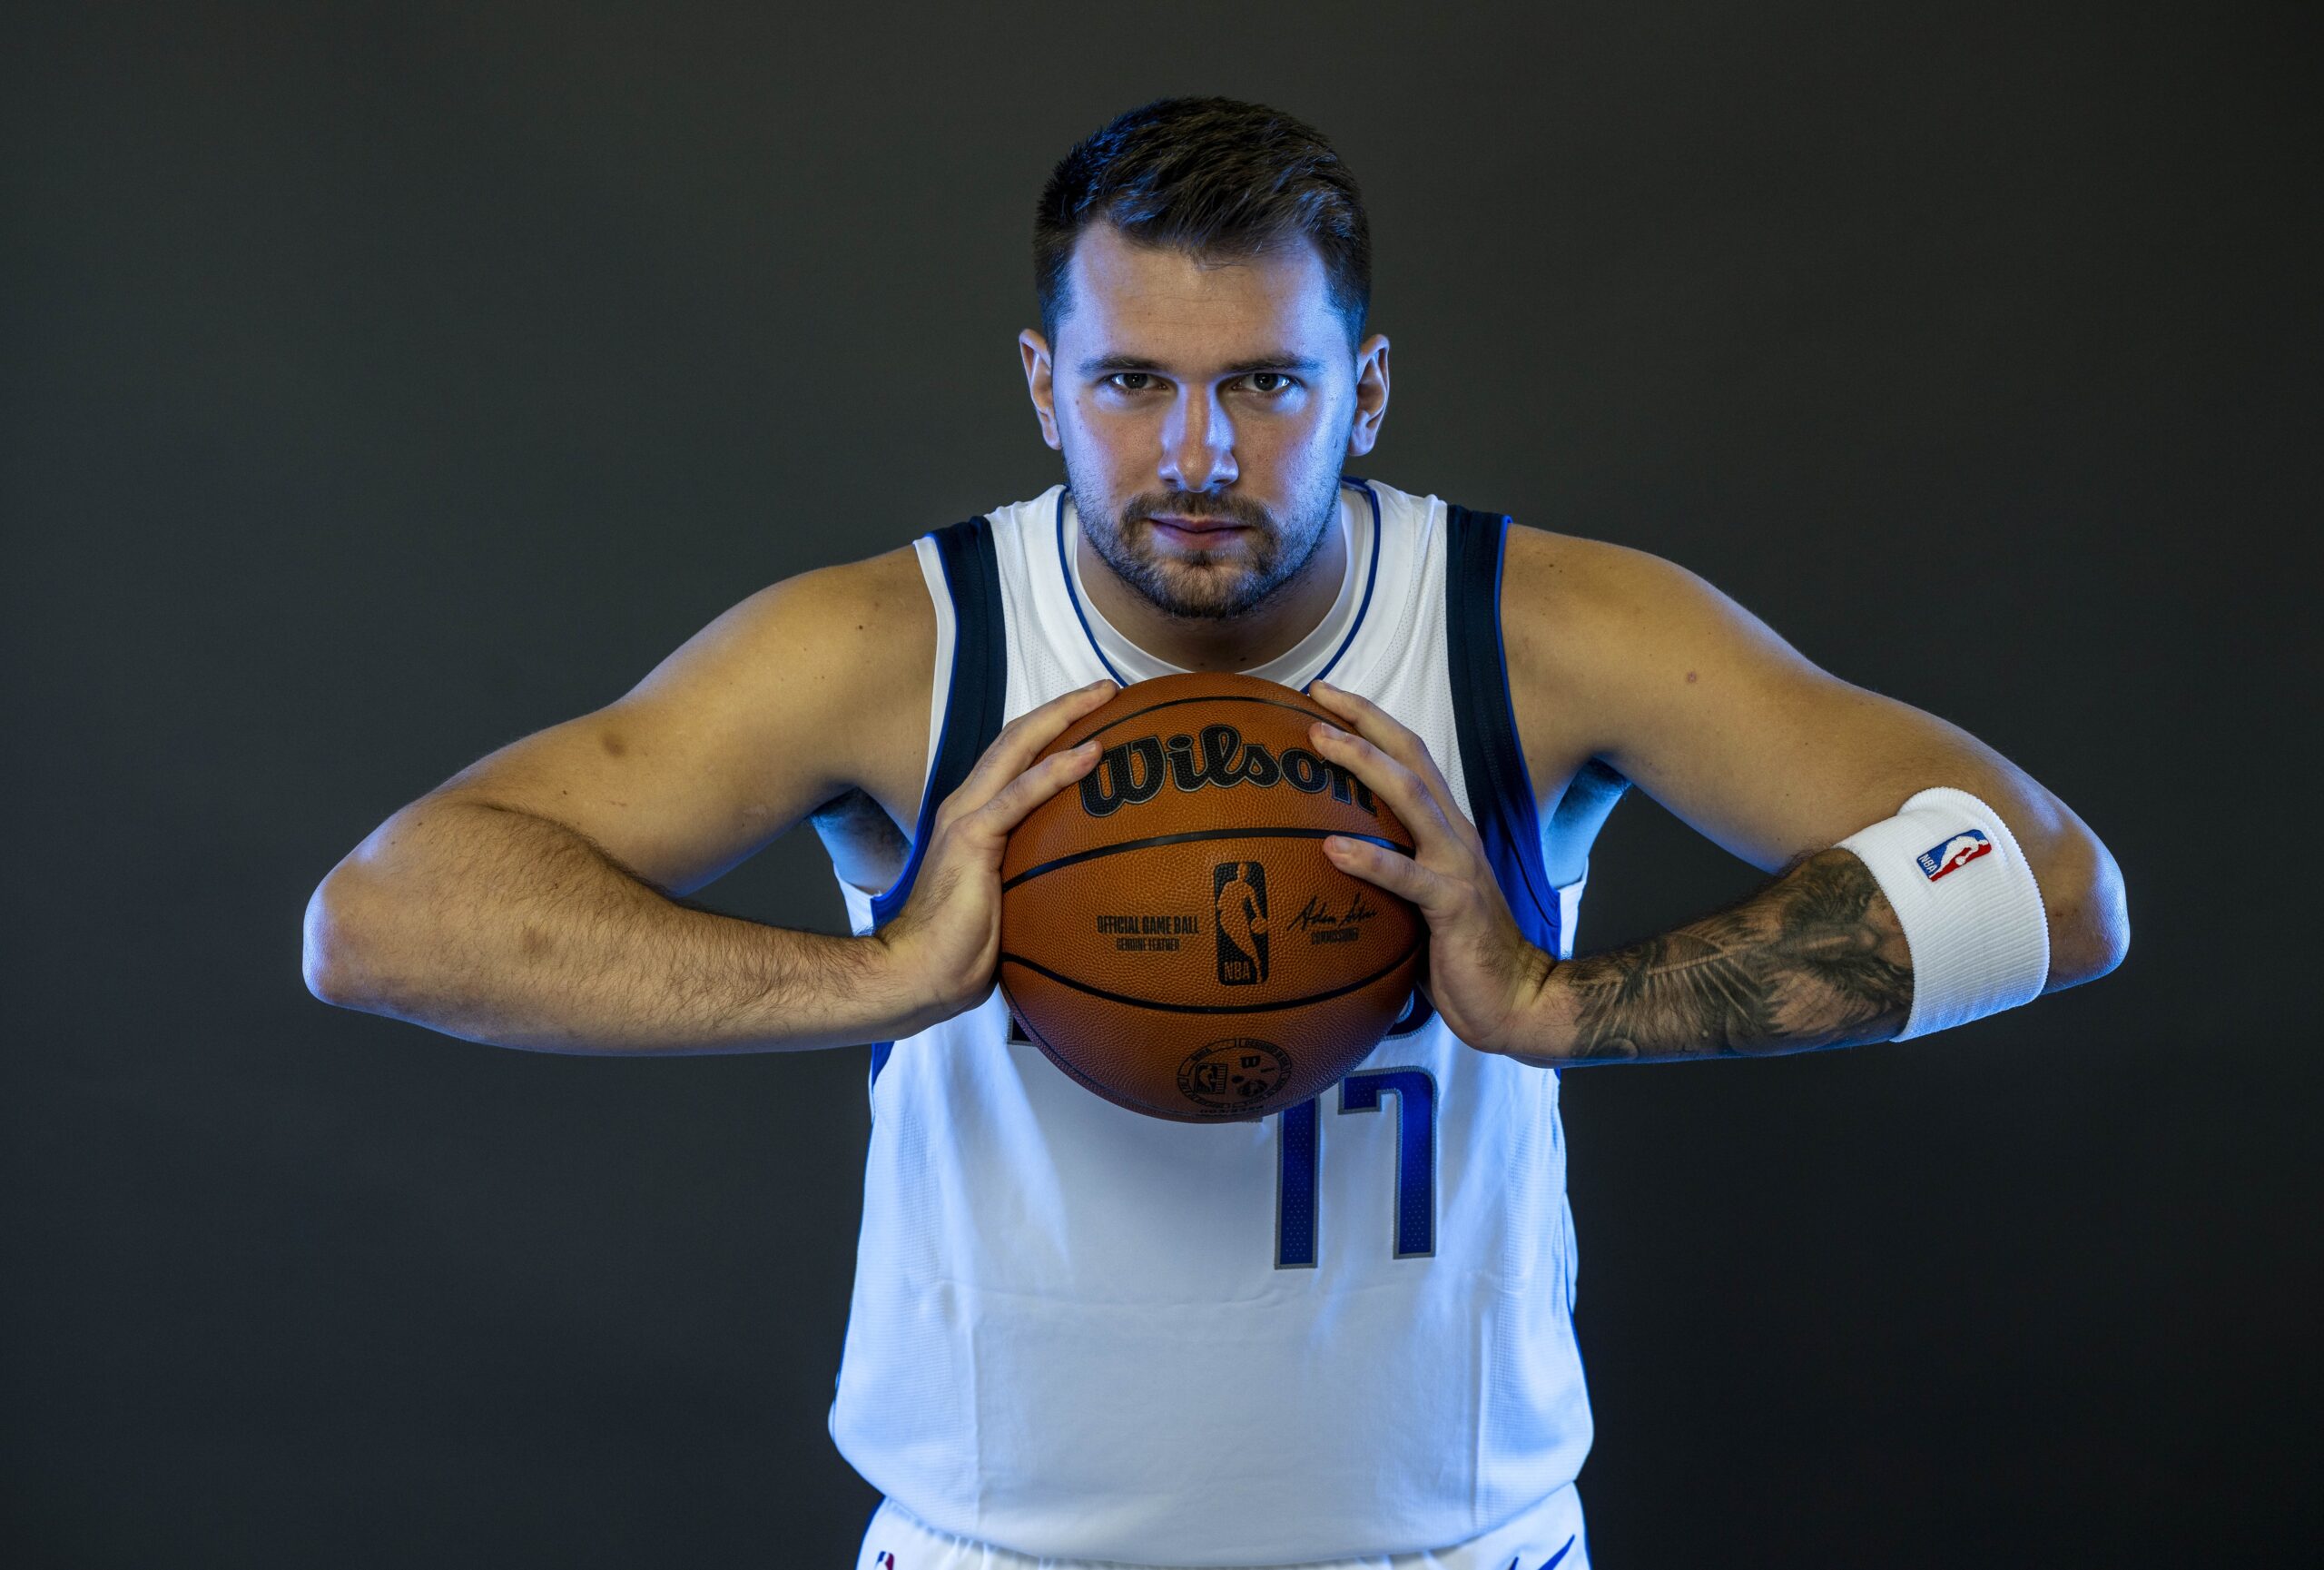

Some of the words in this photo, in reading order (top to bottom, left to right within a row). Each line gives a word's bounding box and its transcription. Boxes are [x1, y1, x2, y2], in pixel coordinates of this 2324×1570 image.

[1079, 724, 1377, 817] Wilson
[1918, 853, 1939, 874] NBA
[1097, 915, 1141, 934] OFFICIAL
[1142, 915, 1171, 934] GAME
[1173, 915, 1200, 934] BALL
[1223, 960, 1253, 982] NBA
